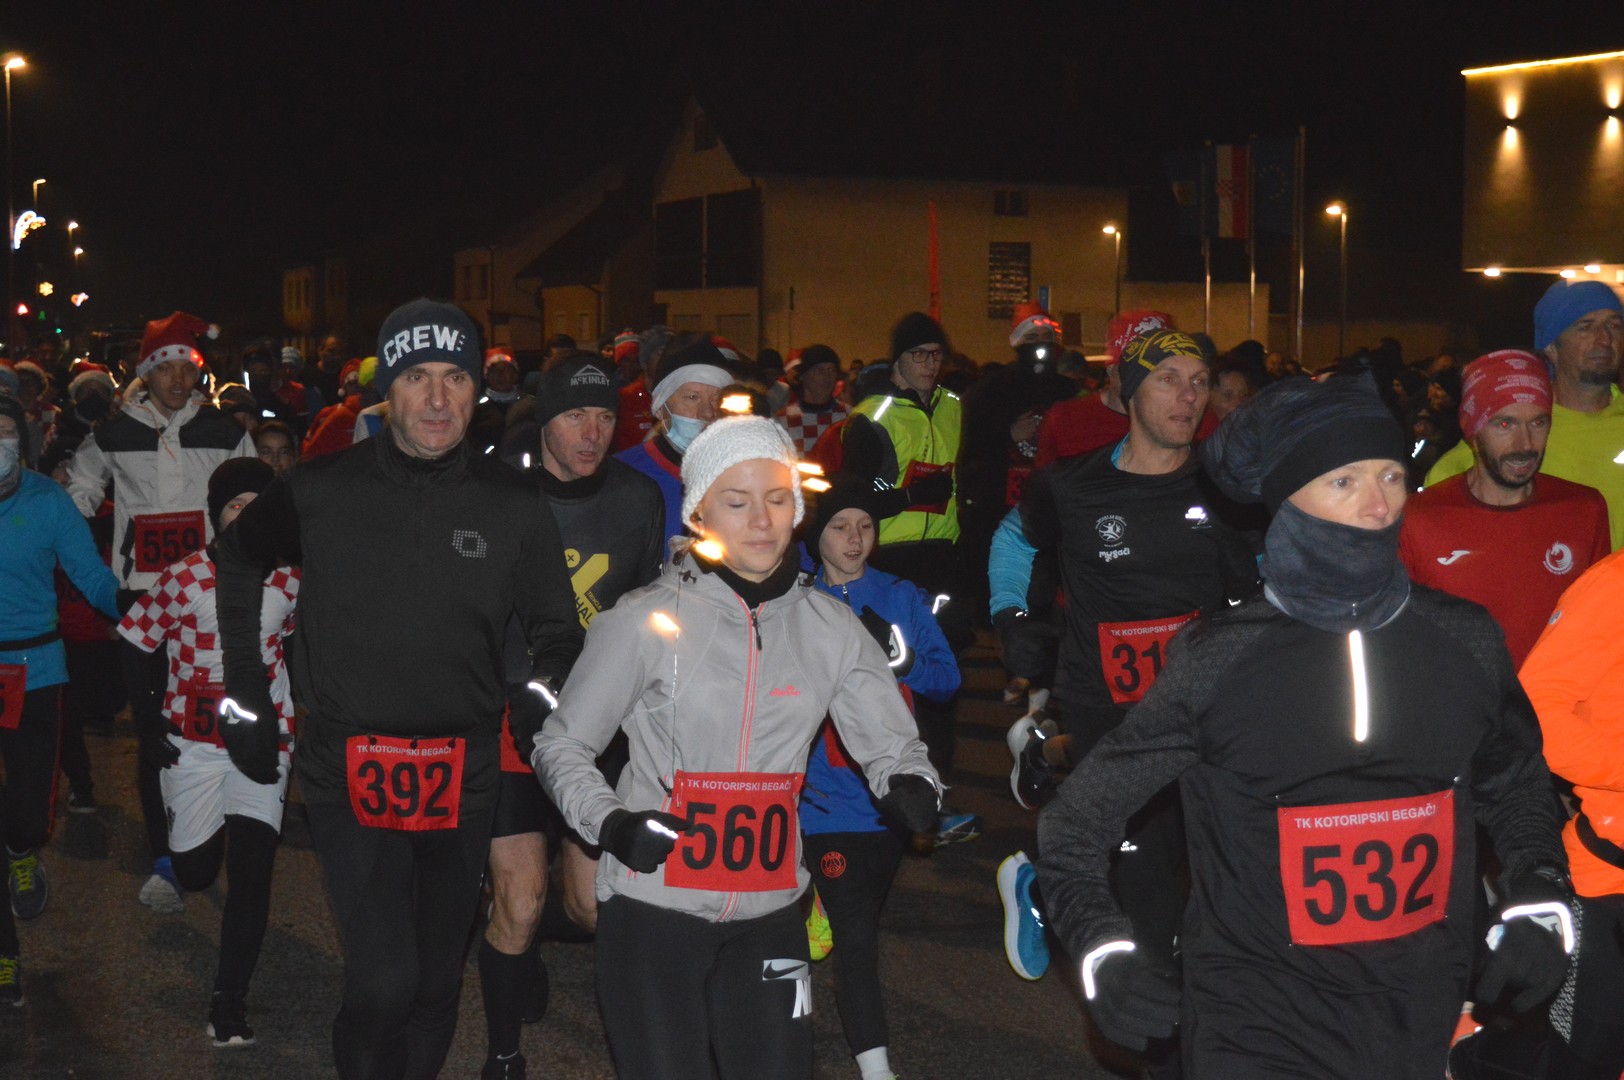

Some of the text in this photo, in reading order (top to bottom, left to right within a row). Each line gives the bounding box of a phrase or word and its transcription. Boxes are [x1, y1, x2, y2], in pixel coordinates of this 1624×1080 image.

[383, 324, 459, 368] CREW
[143, 528, 199, 565] 559
[1110, 629, 1121, 637] TK
[1122, 626, 1167, 637] KOTORIPSKI
[1112, 641, 1162, 693] 31
[194, 696, 217, 736] 5
[357, 745, 369, 754] TK
[358, 760, 453, 818] 392
[687, 779, 792, 791] TK KOTORIPSKI BEGAČI
[1294, 803, 1437, 829] TK KOTORIPSKI BEGAČI
[682, 801, 789, 872] 560
[1302, 833, 1439, 926] 532
